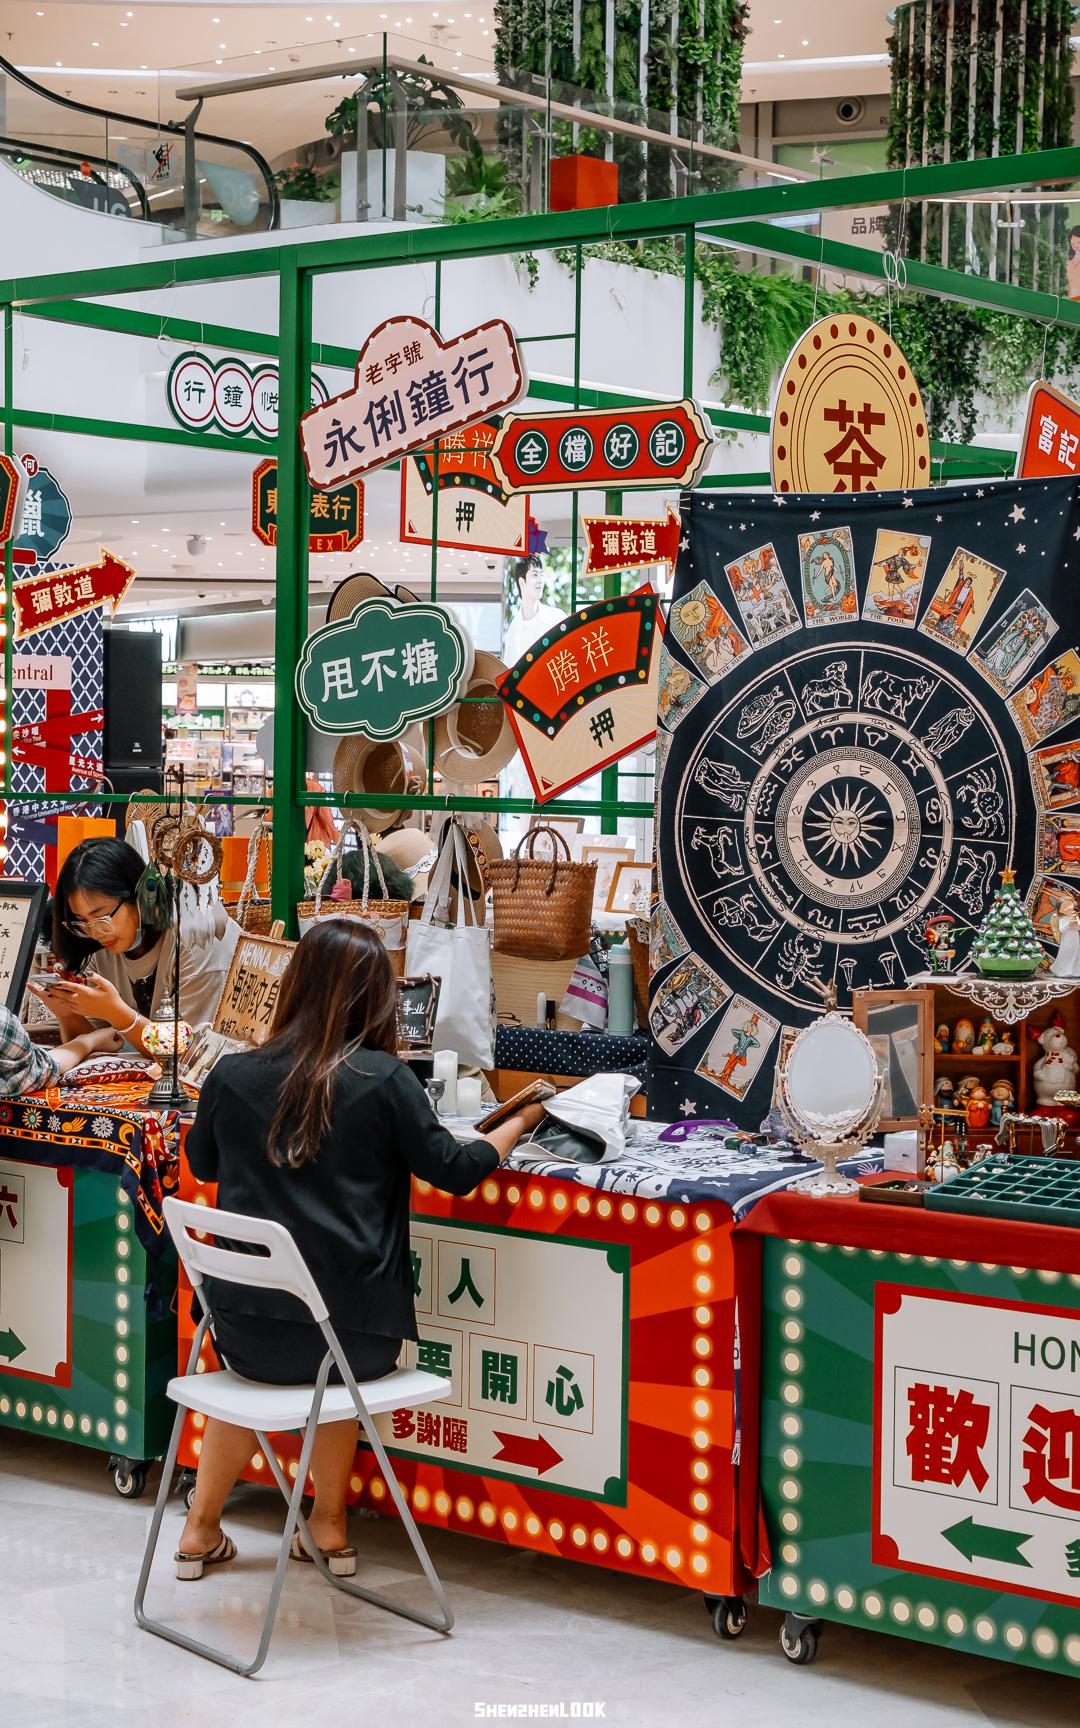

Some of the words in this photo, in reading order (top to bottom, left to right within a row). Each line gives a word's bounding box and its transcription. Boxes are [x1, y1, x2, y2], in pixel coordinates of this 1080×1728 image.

[366, 341, 423, 385] 老字號
[323, 347, 494, 468] 永俐鐘行
[520, 429, 677, 467] 全檔好記
[824, 400, 886, 492] 茶
[1038, 414, 1079, 471] 富記
[455, 500, 476, 533] 押
[602, 529, 657, 556] 彌敦道
[30, 575, 95, 615] 彌敦道
[811, 617, 828, 625] THE
[869, 613, 882, 621] THE
[321, 638, 439, 703] 甩不糖
[716, 665, 733, 678] THE
[589, 707, 615, 749] 押
[1033, 880, 1041, 895] THE
[239, 941, 272, 971] HENNA
[906, 1382, 1080, 1513] 歡迎
